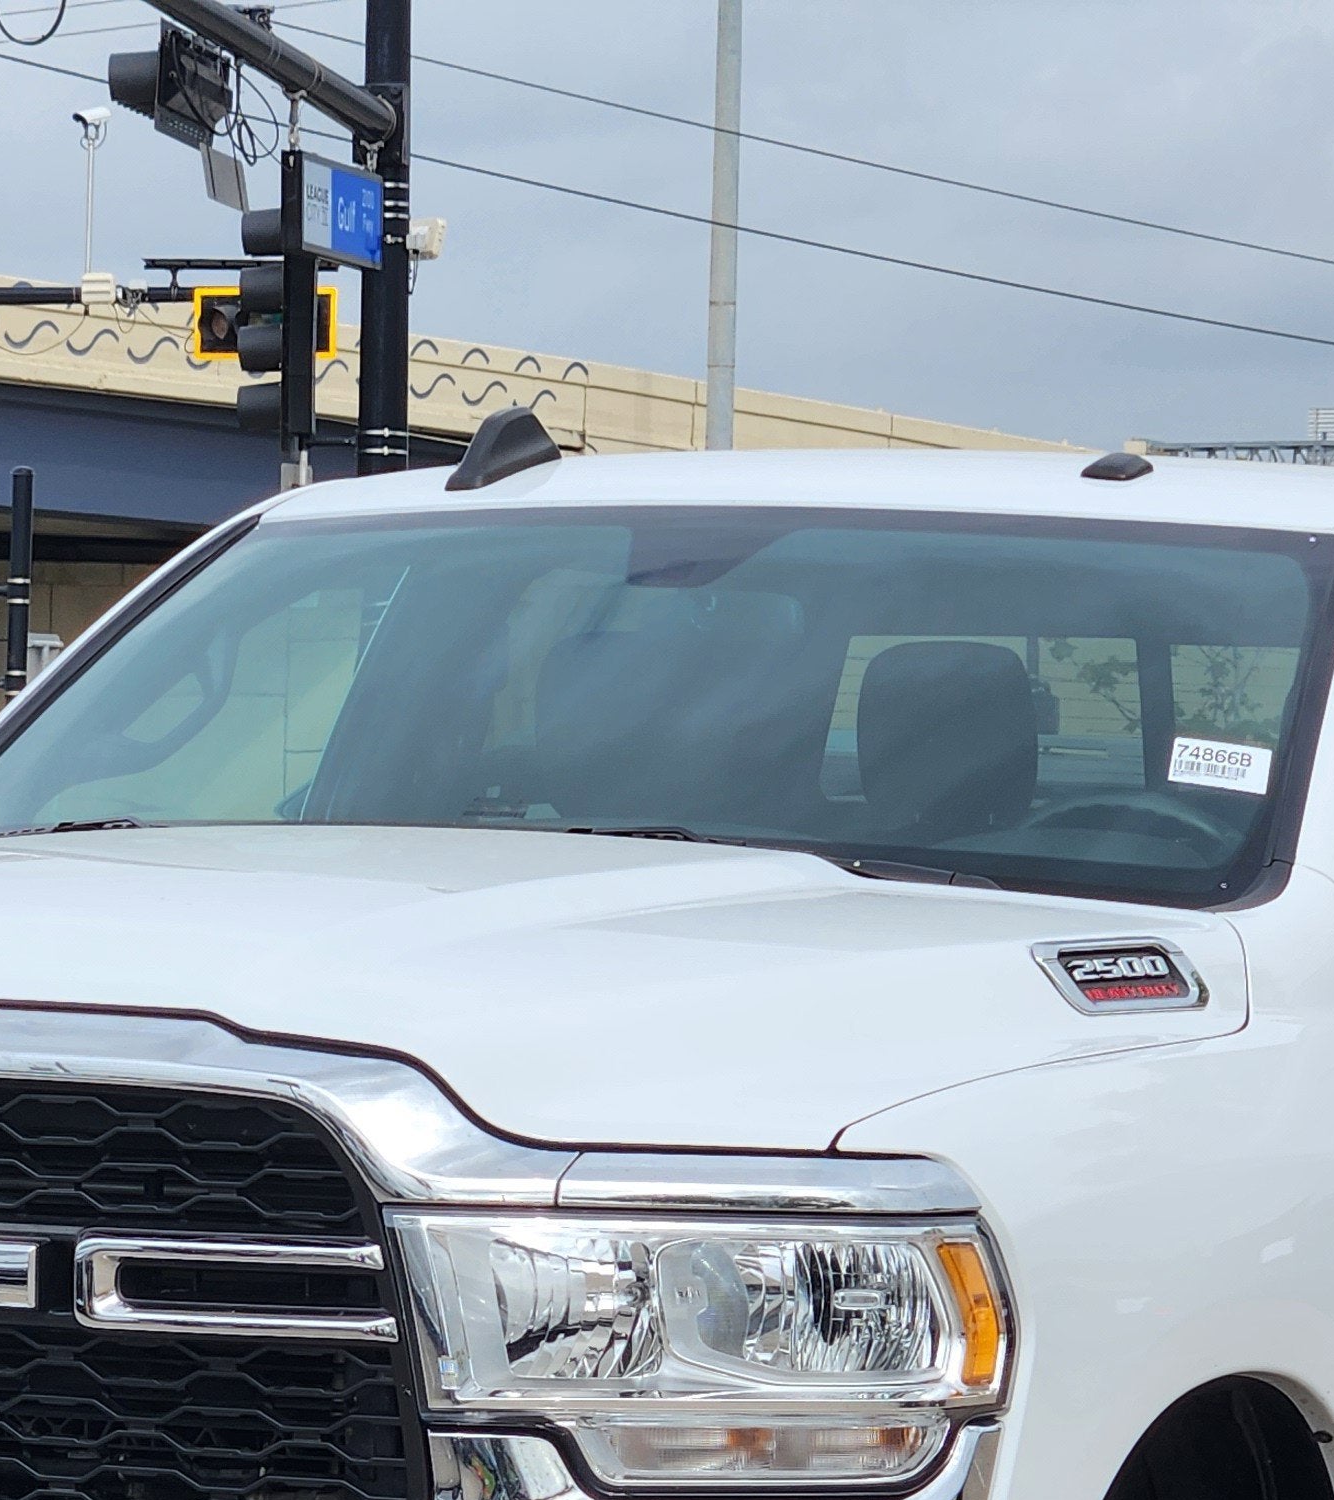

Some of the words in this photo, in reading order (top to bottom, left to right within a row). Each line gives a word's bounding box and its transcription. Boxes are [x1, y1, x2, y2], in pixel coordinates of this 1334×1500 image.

[338, 196, 356, 233] Gulf
[1177, 743, 1252, 767] 74866B
[1068, 955, 1169, 981] 2500
